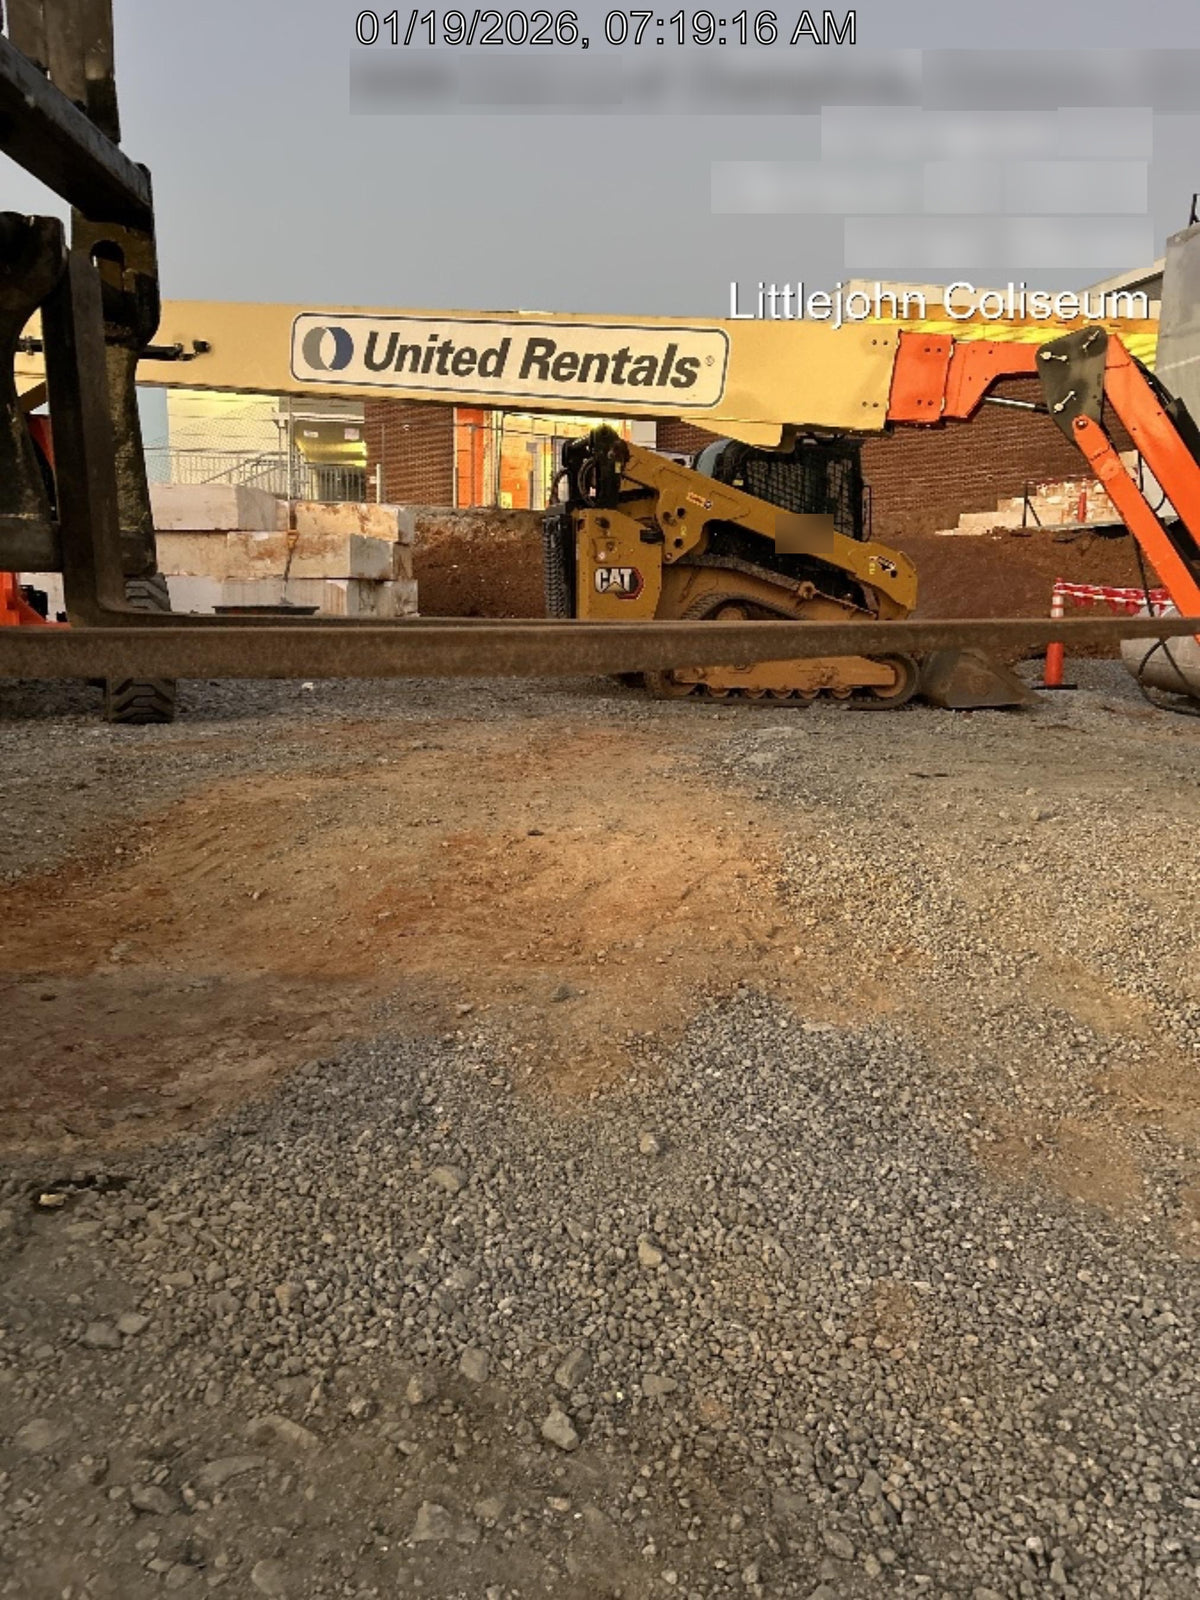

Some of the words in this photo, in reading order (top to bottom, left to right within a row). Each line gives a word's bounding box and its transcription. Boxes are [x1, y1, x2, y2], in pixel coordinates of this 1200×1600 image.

[363, 330, 511, 378] United
[518, 337, 702, 388] Rentals
[595, 568, 632, 592] CAT
